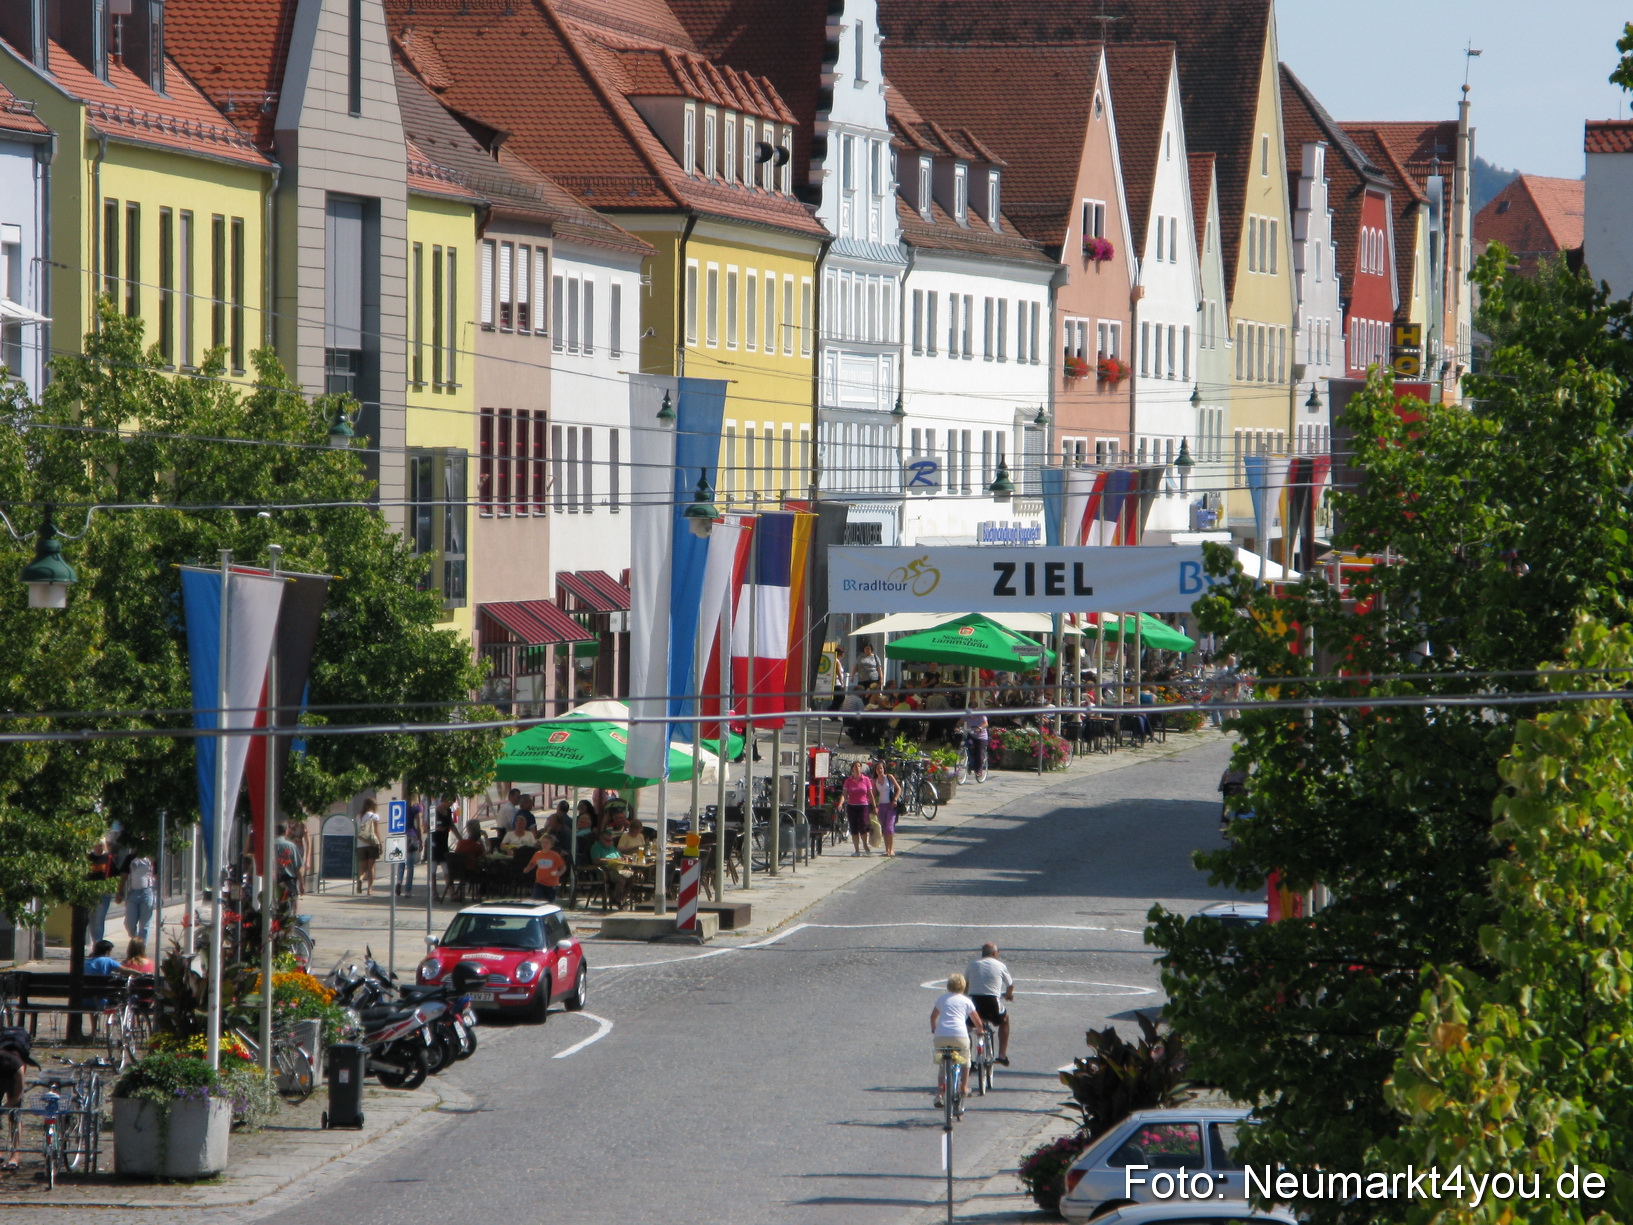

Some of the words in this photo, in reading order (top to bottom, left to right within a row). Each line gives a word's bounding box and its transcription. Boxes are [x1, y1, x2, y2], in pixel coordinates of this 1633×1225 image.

[993, 561, 1093, 596] ZIEL
[931, 637, 989, 649] Lammsbräu
[510, 749, 585, 761] Lammsbräu
[525, 745, 579, 753] Neumarkter
[392, 805, 402, 830] P
